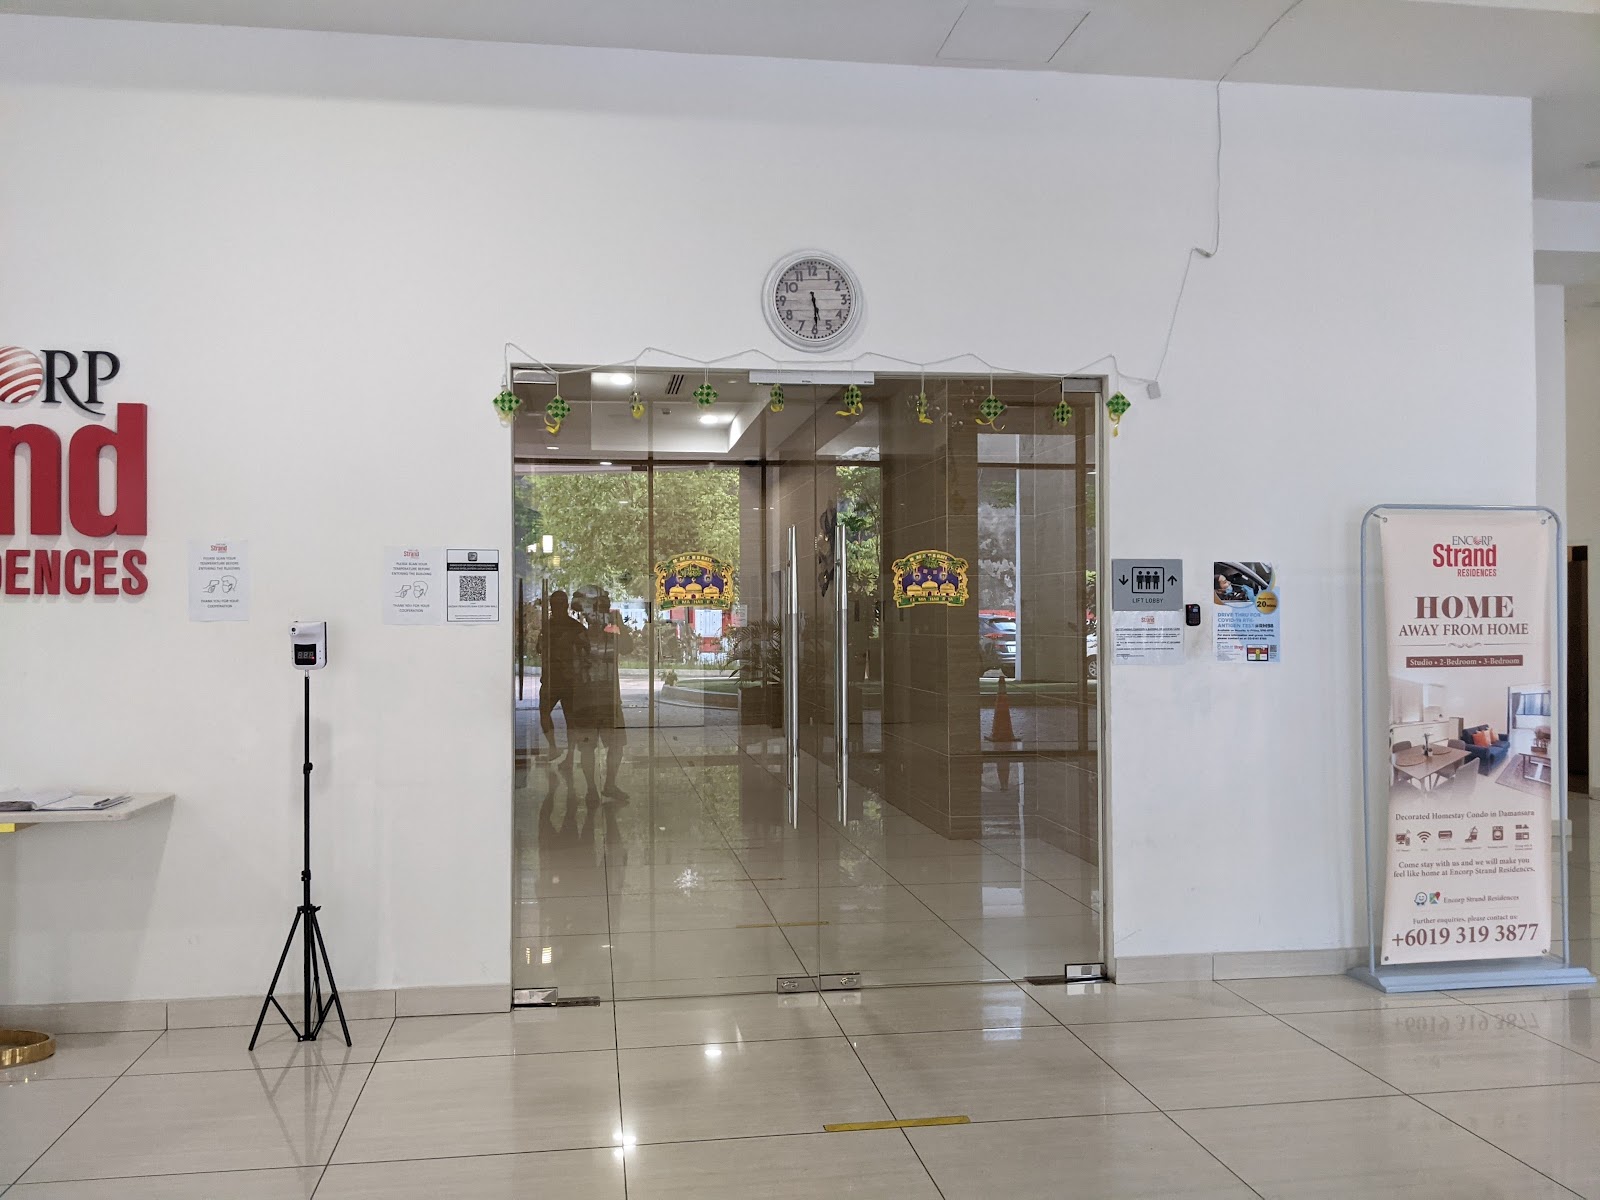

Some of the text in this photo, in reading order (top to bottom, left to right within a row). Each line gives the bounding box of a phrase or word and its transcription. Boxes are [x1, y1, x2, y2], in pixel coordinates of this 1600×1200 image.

[808, 266, 817, 276] 12
[826, 271, 830, 281] 1
[795, 271, 803, 282] 11
[785, 282, 798, 293] 10
[834, 281, 840, 291] 2
[780, 296, 786, 306] 9
[841, 294, 847, 305] 3
[786, 310, 793, 320] 8
[835, 310, 842, 319] 4
[799, 320, 805, 330] 7
[812, 324, 818, 334] 6
[826, 320, 832, 330] 5
[1433, 543, 1496, 567] Strand
[0, 549, 148, 596] ENCES
[1457, 569, 1496, 577] RESIDENCES
[1415, 596, 1513, 619] HOME
[1398, 623, 1529, 636] AWAY FROM HOME
[1395, 812, 1430, 821] Decorated
[1432, 812, 1464, 820] Homestay
[1450, 868, 1474, 876] Encorp
[1391, 923, 1539, 947] +6019 319 3877
